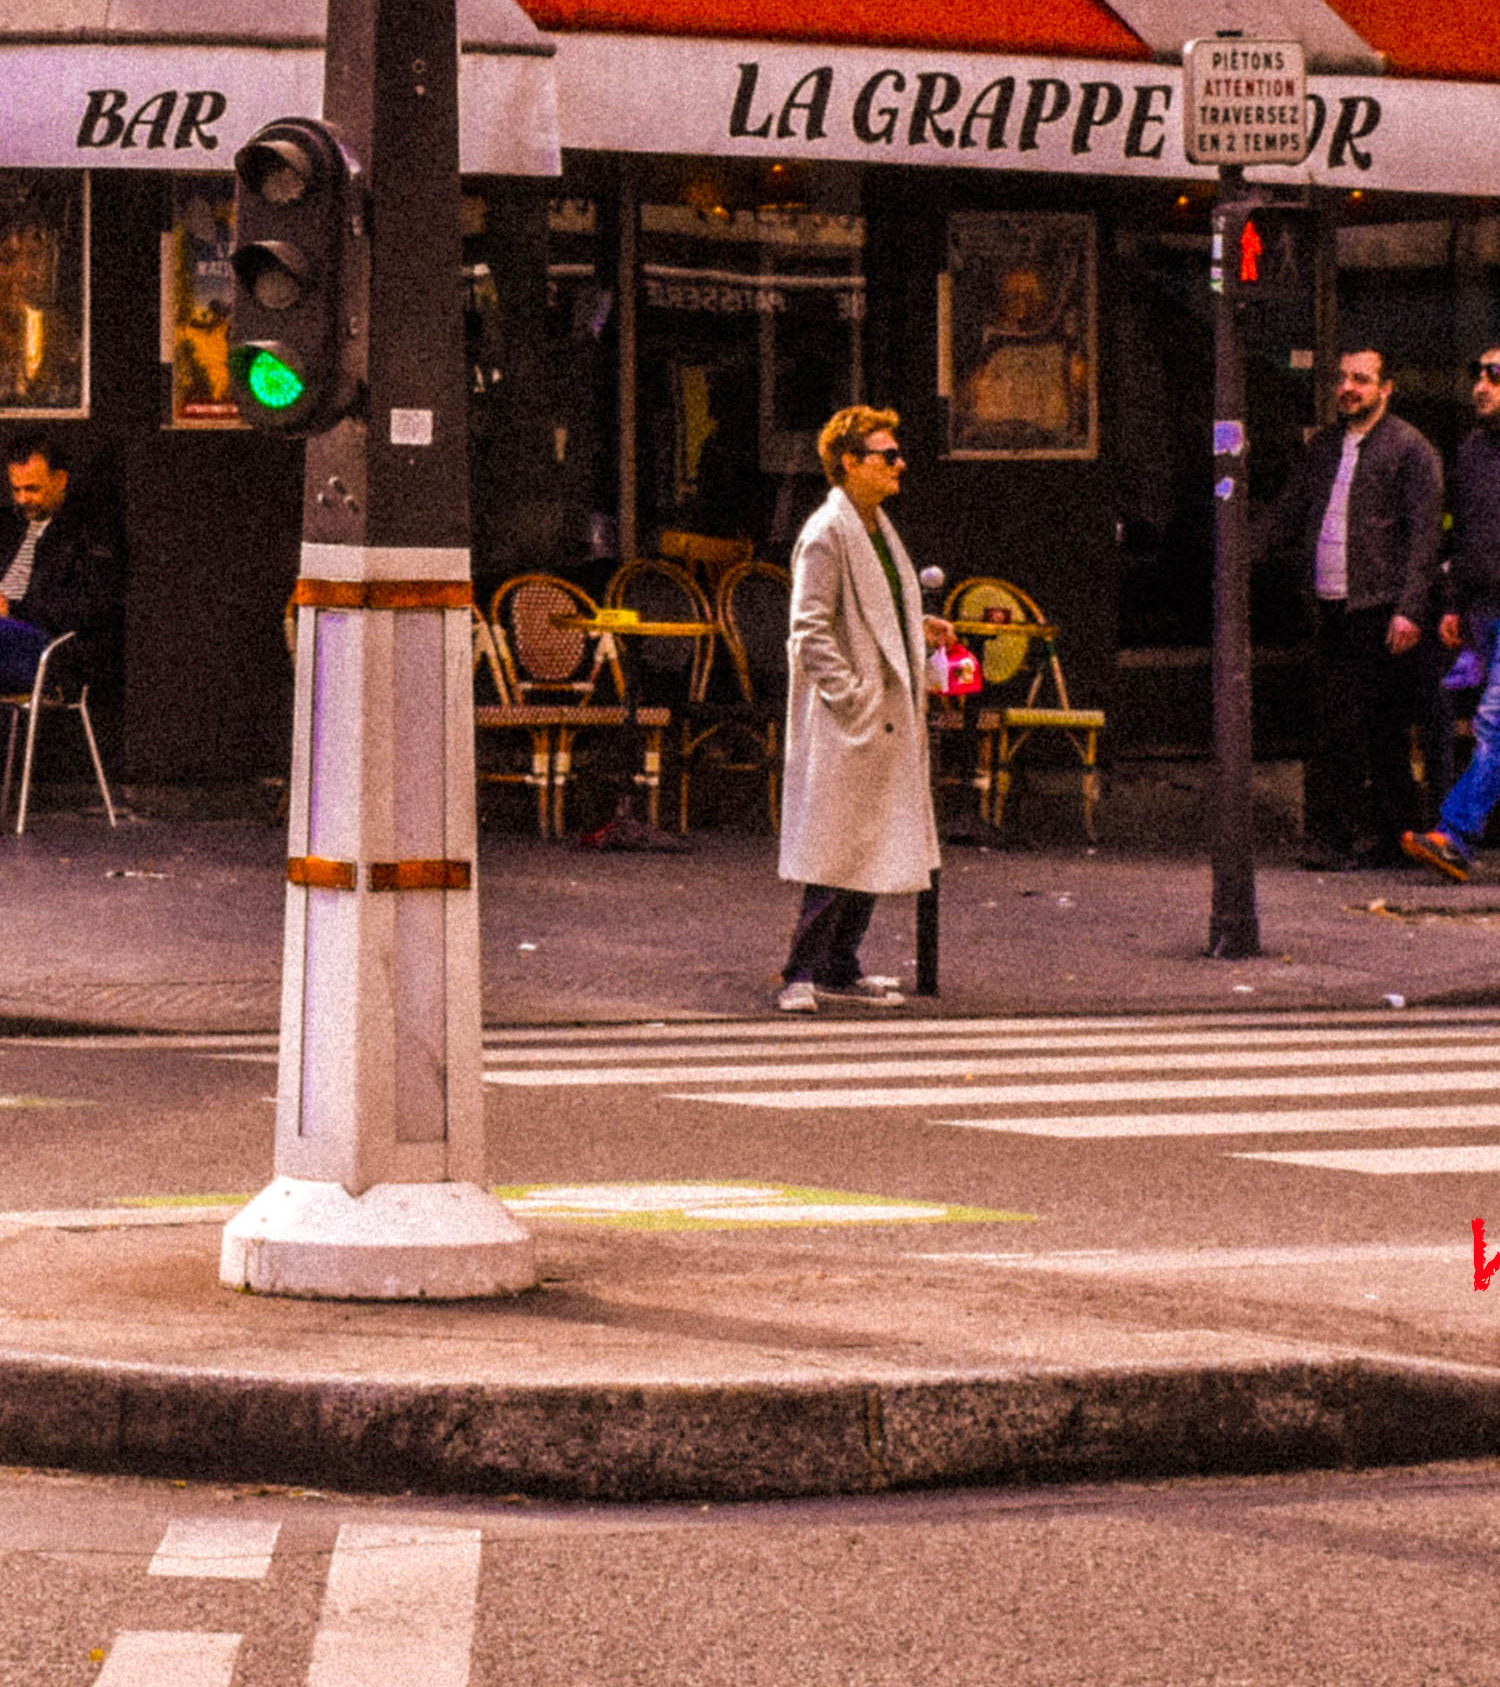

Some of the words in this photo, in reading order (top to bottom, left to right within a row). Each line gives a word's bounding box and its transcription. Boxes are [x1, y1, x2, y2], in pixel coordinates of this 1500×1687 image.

[1205, 79, 1295, 97] ATTENTION
[76, 88, 227, 150] BAR
[729, 61, 835, 141] LA
[852, 69, 1172, 159] GRAPPE
[1200, 106, 1299, 124] TRAVERSEZ
[1198, 134, 1219, 151] EN
[1227, 134, 1235, 151] 2
[1243, 133, 1299, 151] TEMPS
